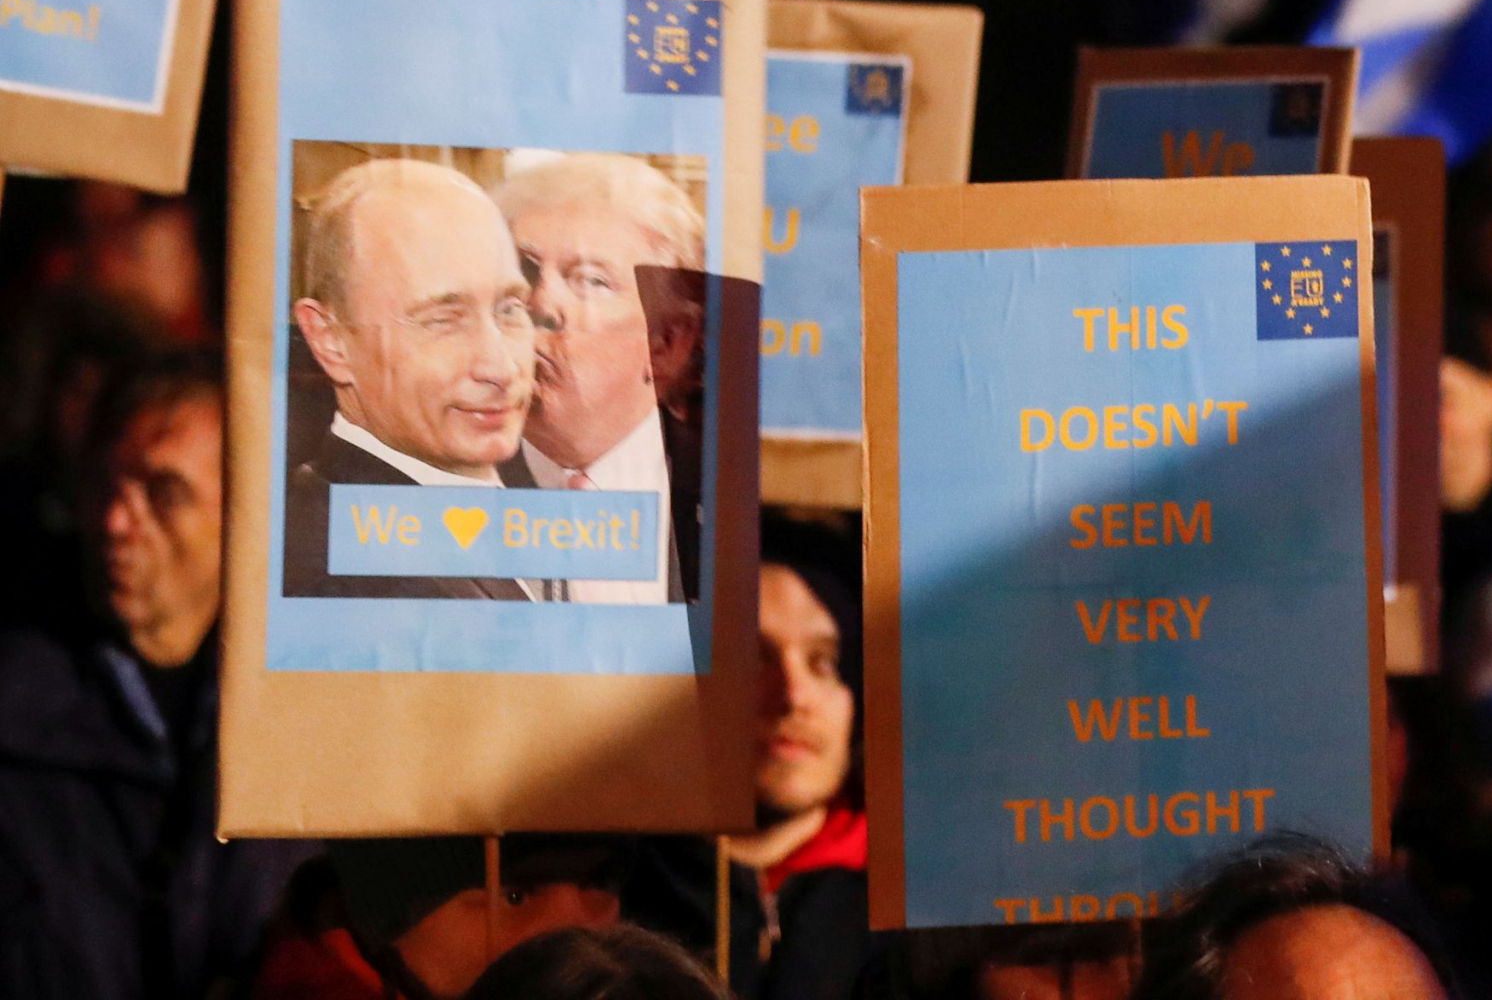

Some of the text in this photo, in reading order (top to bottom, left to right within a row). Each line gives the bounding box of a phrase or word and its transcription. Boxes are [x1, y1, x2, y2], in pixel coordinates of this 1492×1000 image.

[763, 112, 821, 153] ee
[1161, 128, 1257, 175] We
[763, 205, 802, 255] U
[760, 318, 823, 357] on
[1072, 303, 1190, 353] THIS
[1018, 398, 1250, 454] DOESN'T
[350, 504, 641, 552] We Brexit!
[1068, 499, 1214, 551] SEEM
[1074, 594, 1212, 646] VERY
[1066, 693, 1212, 744] WELL
[1002, 787, 1276, 844] THOUGHT
